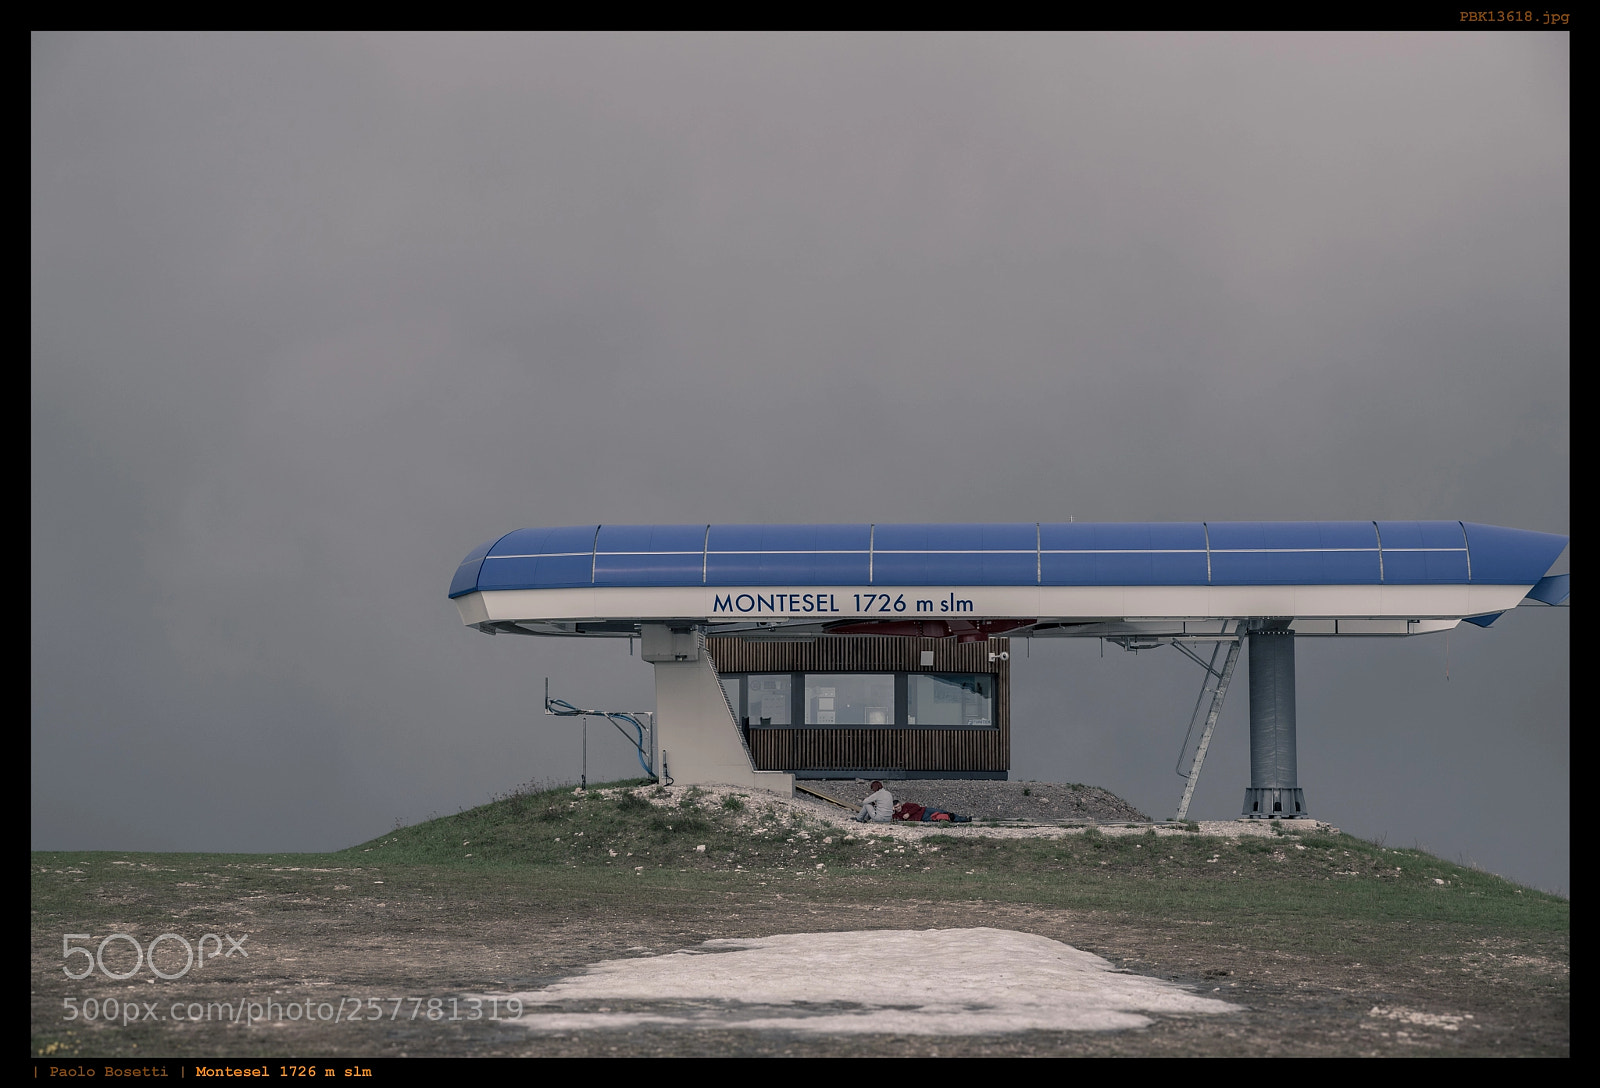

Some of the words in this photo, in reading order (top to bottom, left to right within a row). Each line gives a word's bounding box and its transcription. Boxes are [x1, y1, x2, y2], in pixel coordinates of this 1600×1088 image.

[713, 593, 839, 612] MONTESEL
[853, 593, 906, 612] 1726
[916, 599, 934, 612] m
[940, 592, 974, 612] slm
